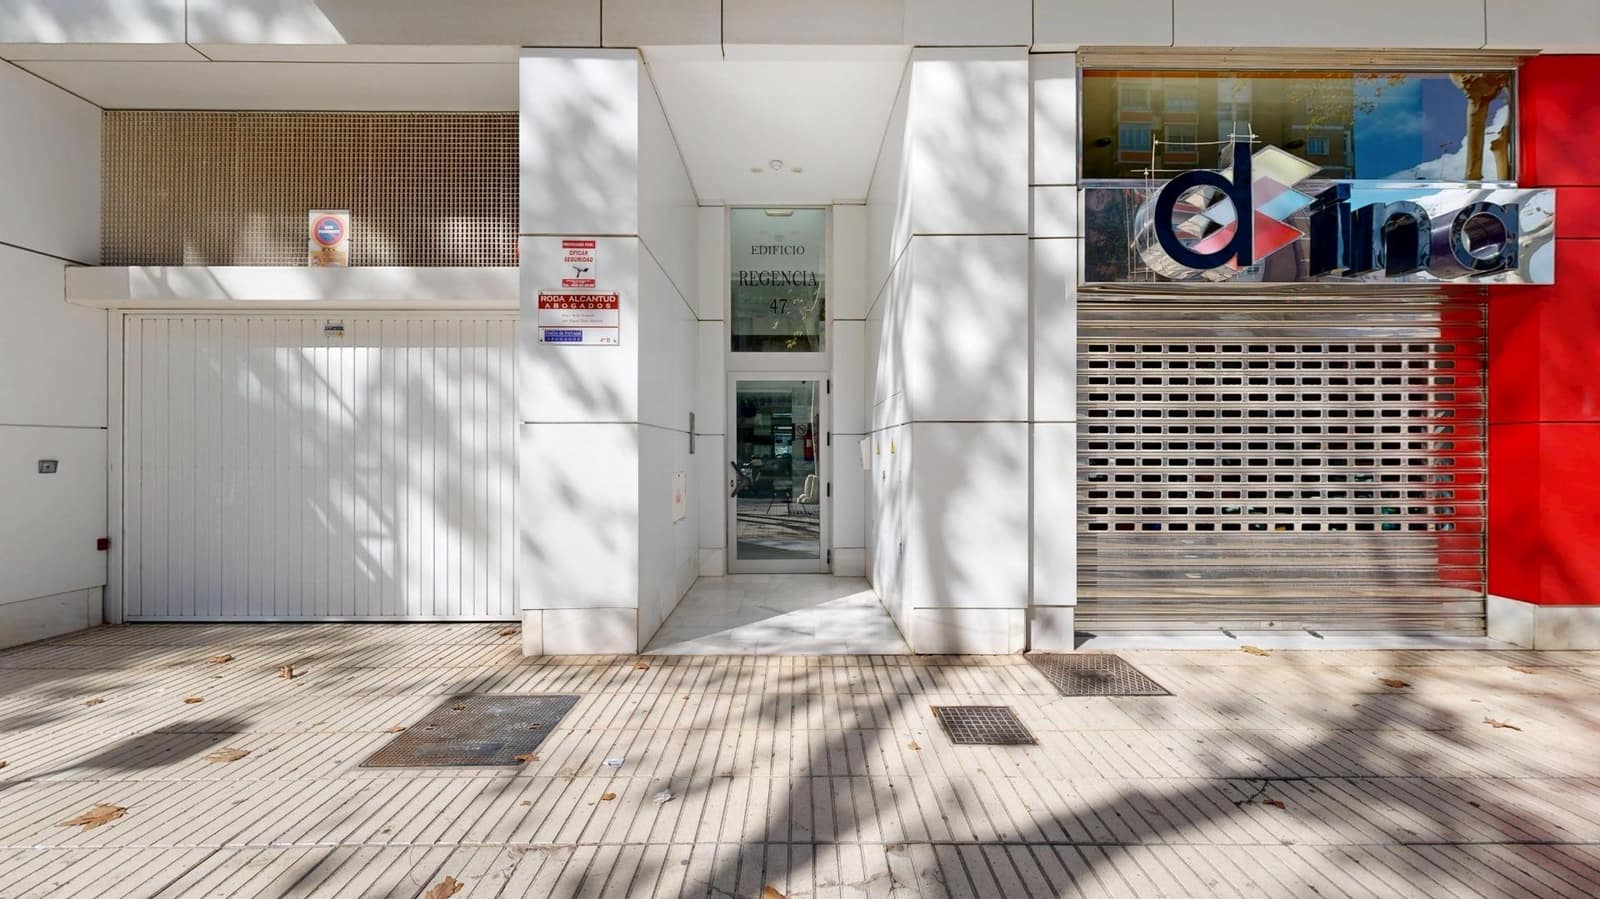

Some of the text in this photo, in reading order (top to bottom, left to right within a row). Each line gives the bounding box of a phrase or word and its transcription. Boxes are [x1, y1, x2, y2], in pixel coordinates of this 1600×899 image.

[751, 245, 805, 255] EDIFICIO
[738, 270, 818, 287] REGENCIA
[769, 299, 788, 314] 47
